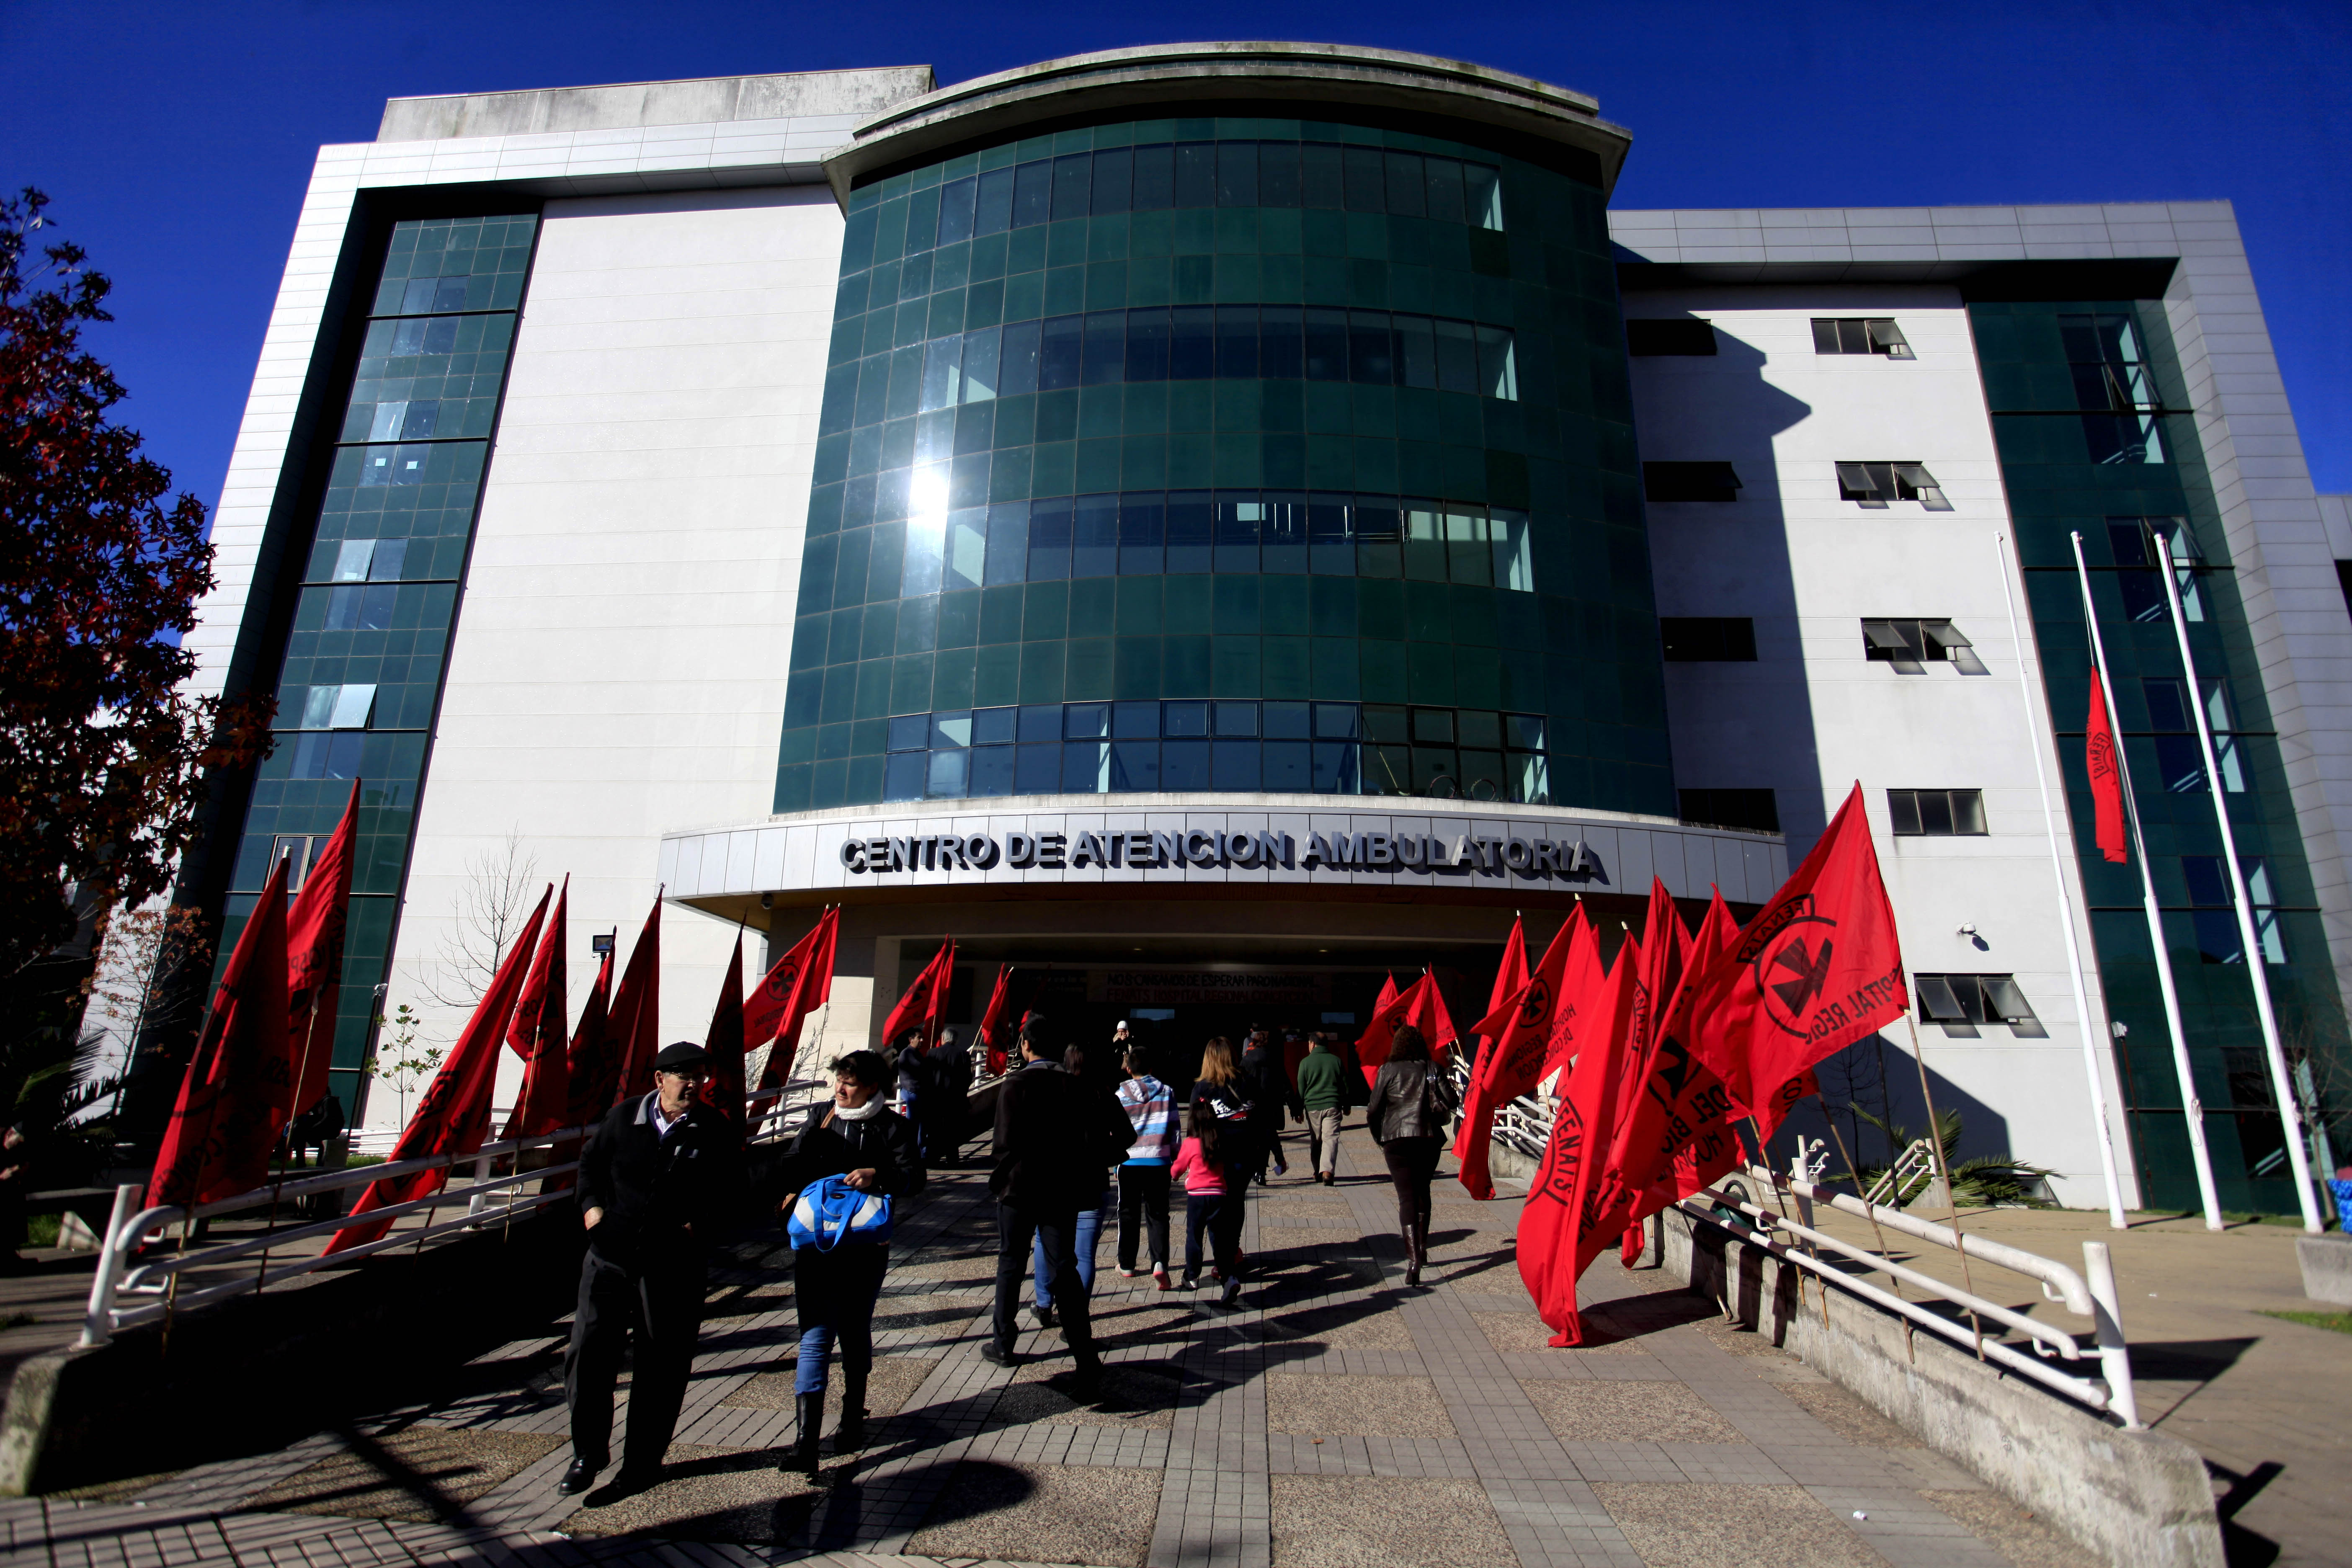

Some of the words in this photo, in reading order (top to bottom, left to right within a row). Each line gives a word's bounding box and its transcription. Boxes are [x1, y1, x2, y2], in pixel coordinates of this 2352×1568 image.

[839, 832, 993, 869] CENTRO
[1006, 831, 1060, 863] DE
[1068, 829, 1285, 863] ATENCION
[1297, 830, 1598, 873] AMBULATORIA
[1107, 974, 1132, 986] NOS
[1186, 974, 1200, 986] DE
[1201, 975, 1245, 987] ESPERAR
[1246, 975, 1270, 986] PARO
[1107, 988, 1151, 1002] FENATS
[1154, 989, 1204, 1002] HOSPITAL
